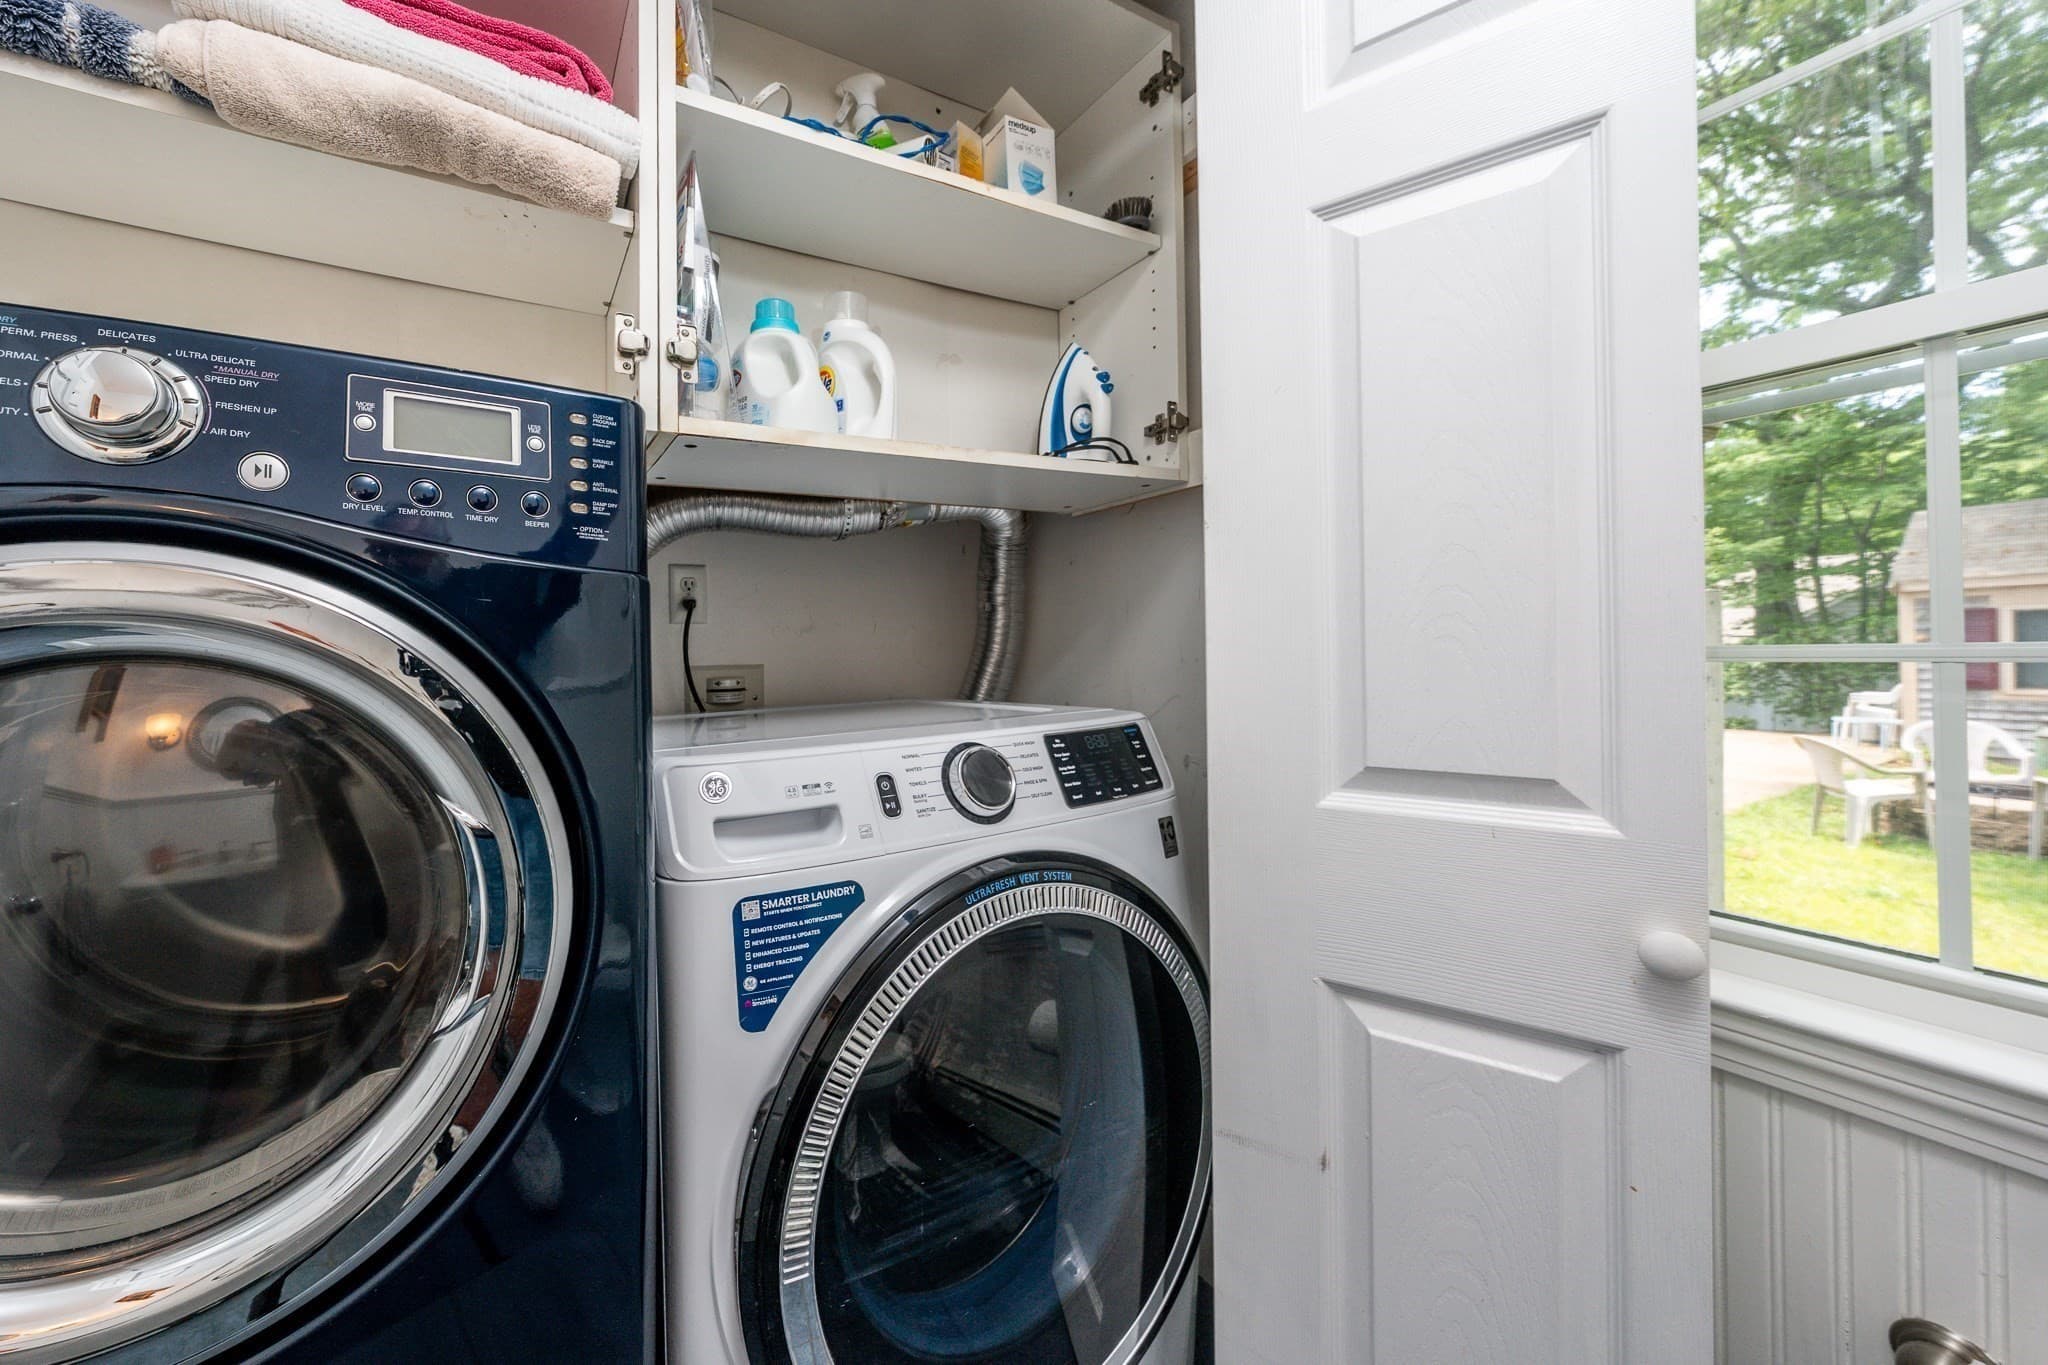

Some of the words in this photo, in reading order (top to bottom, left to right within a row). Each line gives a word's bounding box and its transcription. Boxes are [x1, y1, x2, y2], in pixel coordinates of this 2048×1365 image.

[1008, 120, 1037, 134] medsup
[0, 326, 37, 337] PERM.
[40, 331, 78, 343] PRESS
[97, 328, 156, 343] DELICATES
[175, 349, 208, 361] ULTRA
[210, 354, 256, 367] DELICATE
[204, 374, 237, 386] SPEED
[239, 379, 260, 389] DRY
[261, 371, 280, 379] DRY
[215, 401, 261, 414] FRESHEN
[263, 406, 277, 416] UP
[209, 427, 228, 436] AIR
[230, 430, 251, 439] DRY
[342, 502, 359, 510] DRY
[361, 504, 386, 512] LEVEL
[398, 507, 418, 516] TEMP.
[420, 508, 455, 519] CONTROL
[465, 514, 484, 522] TIME
[484, 516, 499, 524] DRY
[524, 520, 550, 529] BEEPER
[579, 526, 603, 534] OPTION
[965, 877, 1016, 905] ULTRAFRESH
[1019, 872, 1040, 884] VENT
[1043, 871, 1072, 881] SYSTEM
[762, 894, 809, 909] SMARTER
[811, 885, 856, 901] LAUNDRY
[750, 925, 773, 934] REMOTE
[773, 921, 799, 931] CONTROL
[804, 914, 842, 924] NOTIFICATIONS
[751, 939, 765, 947] NEW
[765, 934, 792, 944] FEATURES
[798, 929, 820, 938] UPDATES
[753, 949, 782, 958] ENHANCED
[783, 943, 809, 952] CLEANING
[753, 961, 775, 970] ENERGY
[776, 956, 803, 965] TRACKING
